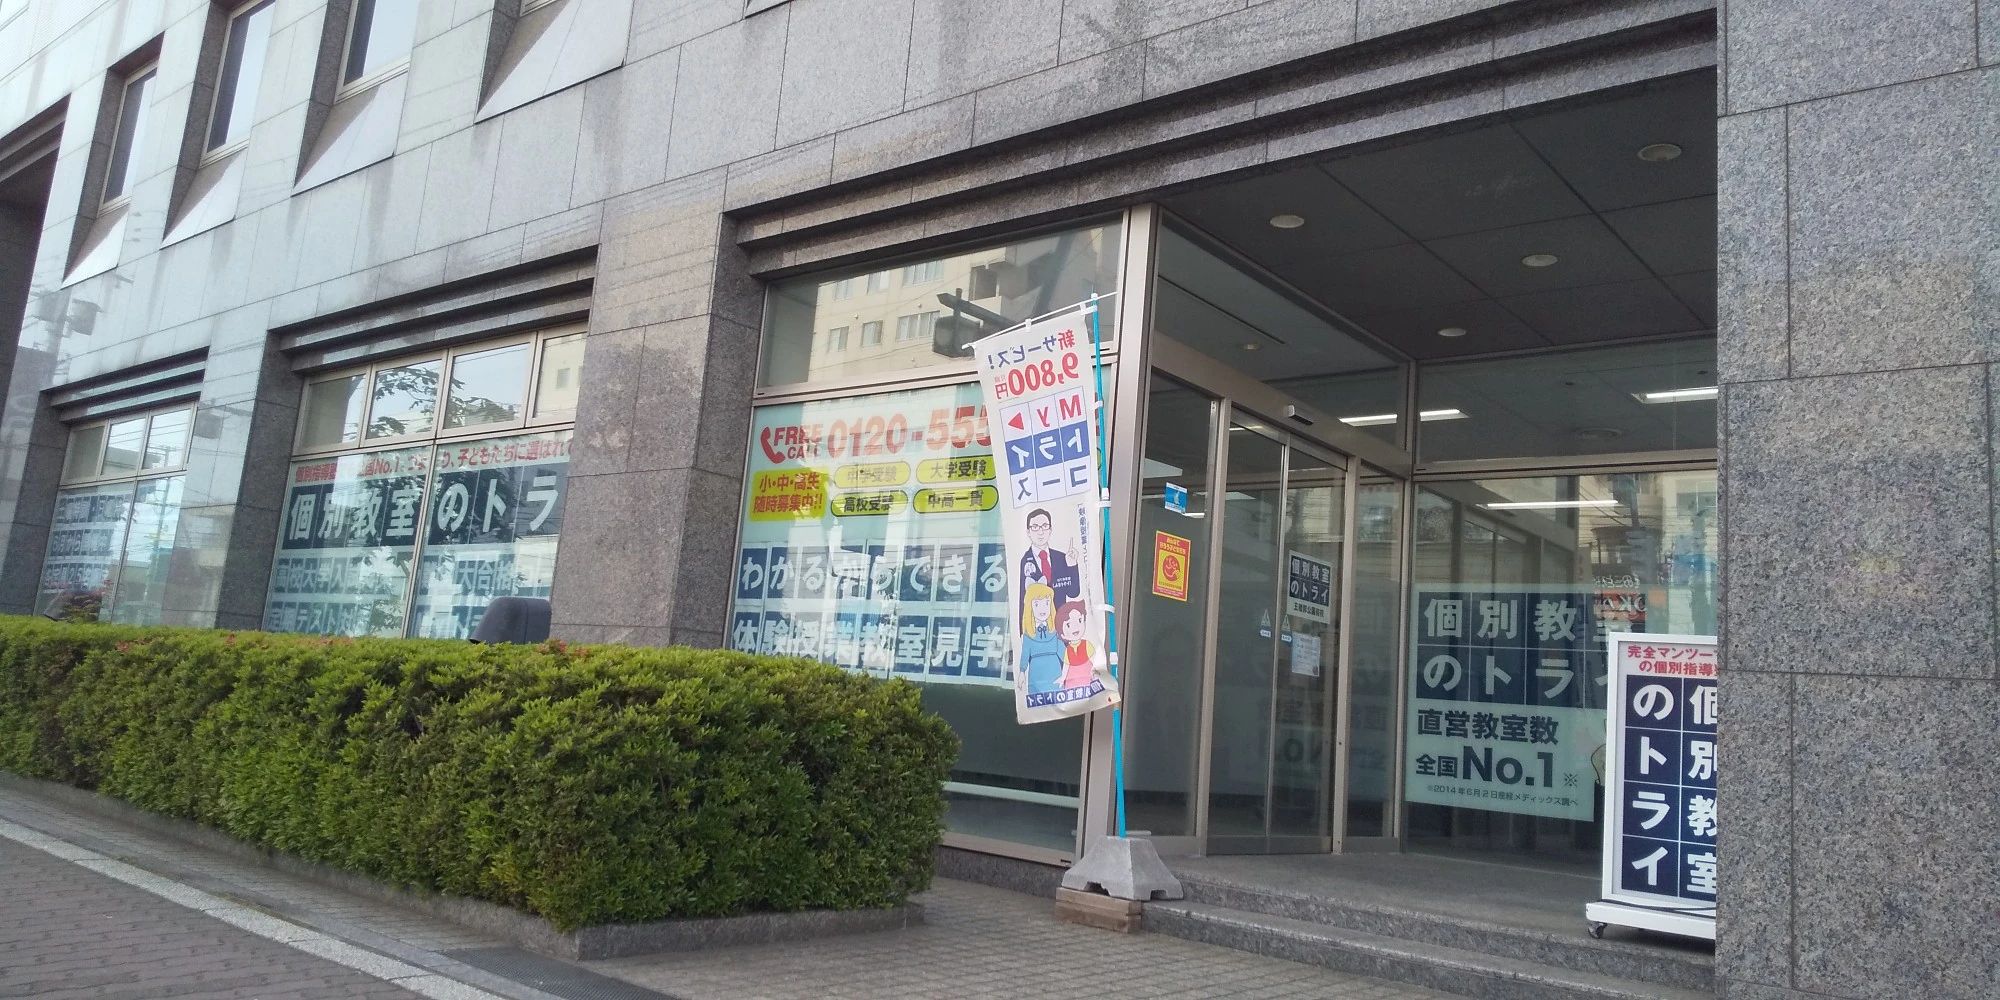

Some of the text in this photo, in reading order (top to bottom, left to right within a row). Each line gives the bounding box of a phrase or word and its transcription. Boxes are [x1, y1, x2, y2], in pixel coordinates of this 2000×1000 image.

[774, 424, 823, 446] FREE
[931, 458, 987, 479] 大学受験
[928, 490, 983, 509] 中高一貫
[1292, 559, 1330, 583] 個別教室
[1291, 580, 1329, 603] のトライ
[1627, 645, 1718, 660] 完全マンツー
[1417, 708, 1559, 745] 直営教室数
[1632, 684, 1675, 886] のトライ
